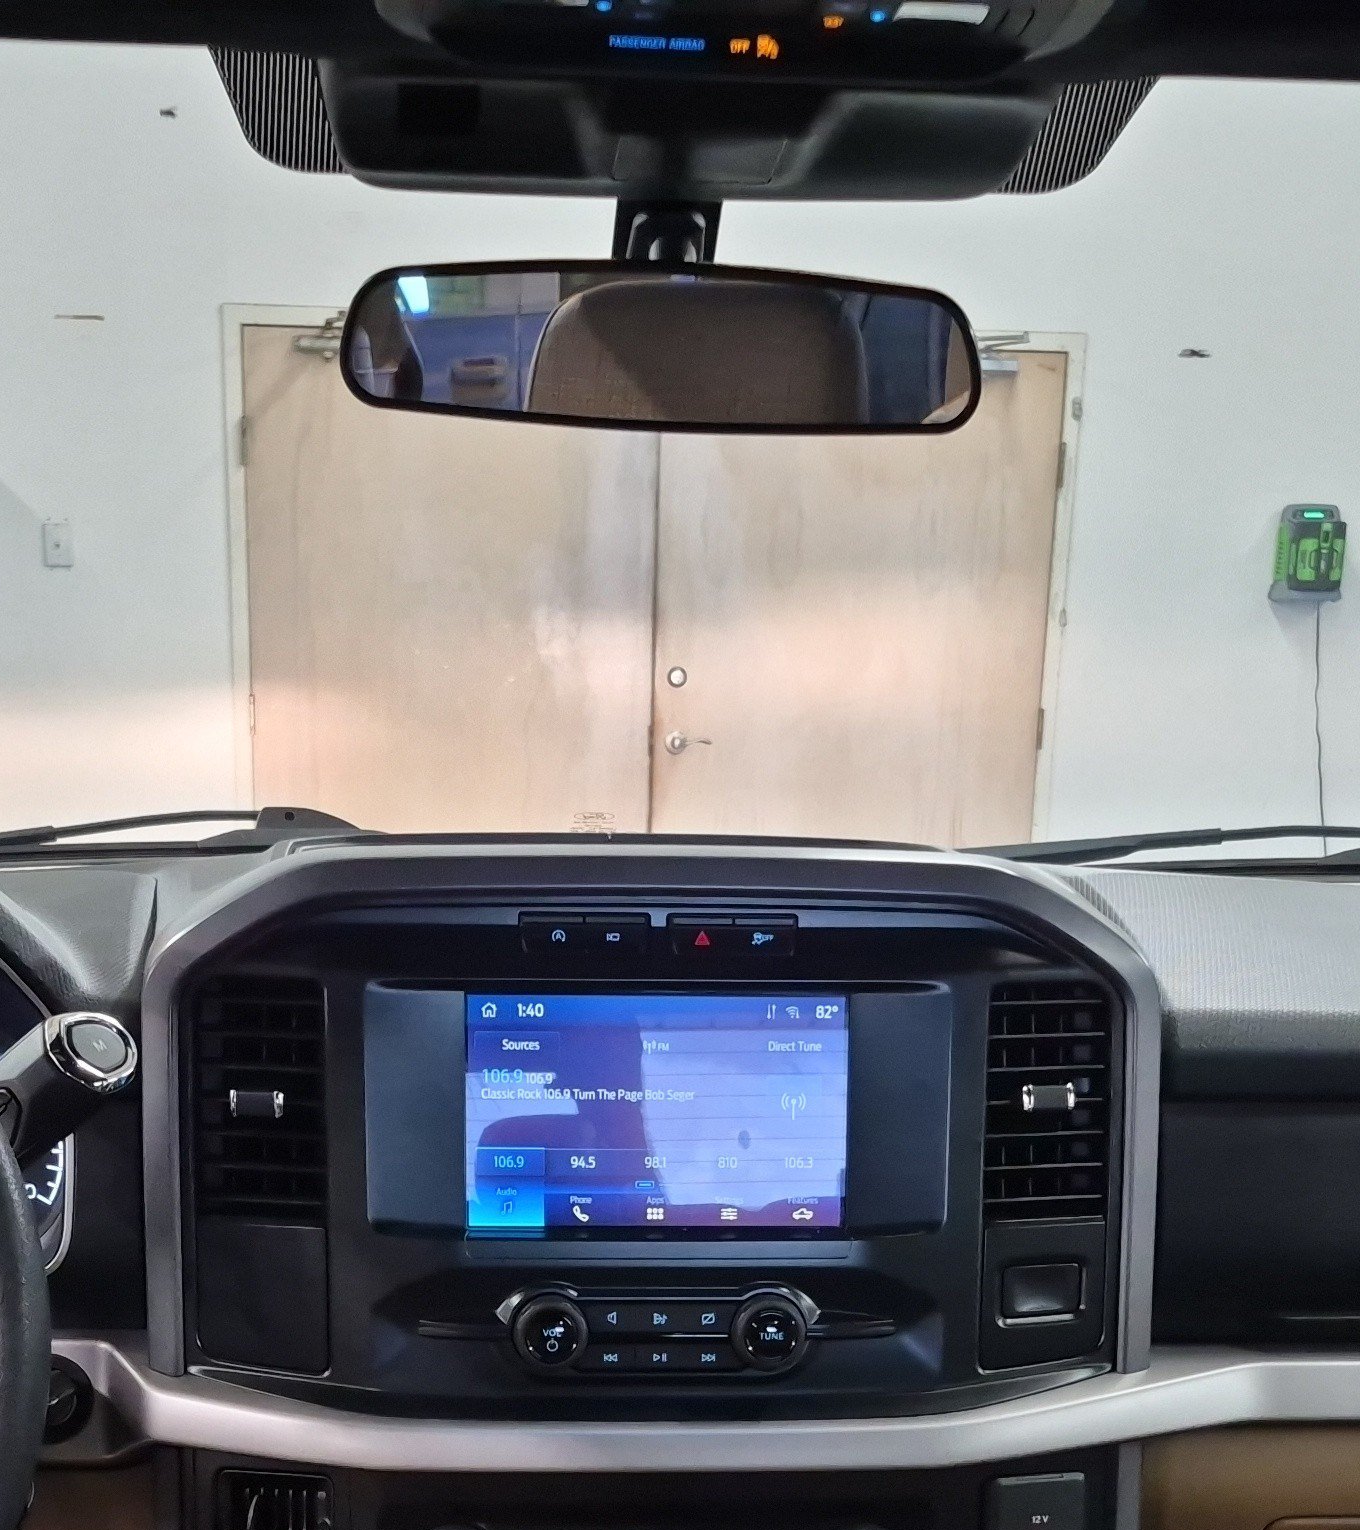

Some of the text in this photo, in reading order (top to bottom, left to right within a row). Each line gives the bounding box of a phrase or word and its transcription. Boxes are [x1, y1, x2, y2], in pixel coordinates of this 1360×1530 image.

[729, 38, 750, 54] OFF
[517, 1003, 544, 1018] 1:40
[815, 1005, 839, 1019] 82°
[501, 1038, 541, 1051] Sources
[767, 1040, 822, 1052] Direct Tune
[482, 1068, 554, 1084] 106.9 106.9
[481, 1088, 696, 1103] Classic Rock 106.9 Turn The Page Bob Seger
[493, 1155, 525, 1169] 106.9
[569, 1155, 597, 1169] 94.5
[644, 1156, 667, 1169] 98.1
[717, 1156, 738, 1169] 810
[784, 1156, 814, 1169] 106.3
[495, 1187, 517, 1196] Audio
[569, 1195, 593, 1205] Phone
[758, 1331, 785, 1341] TUNE
